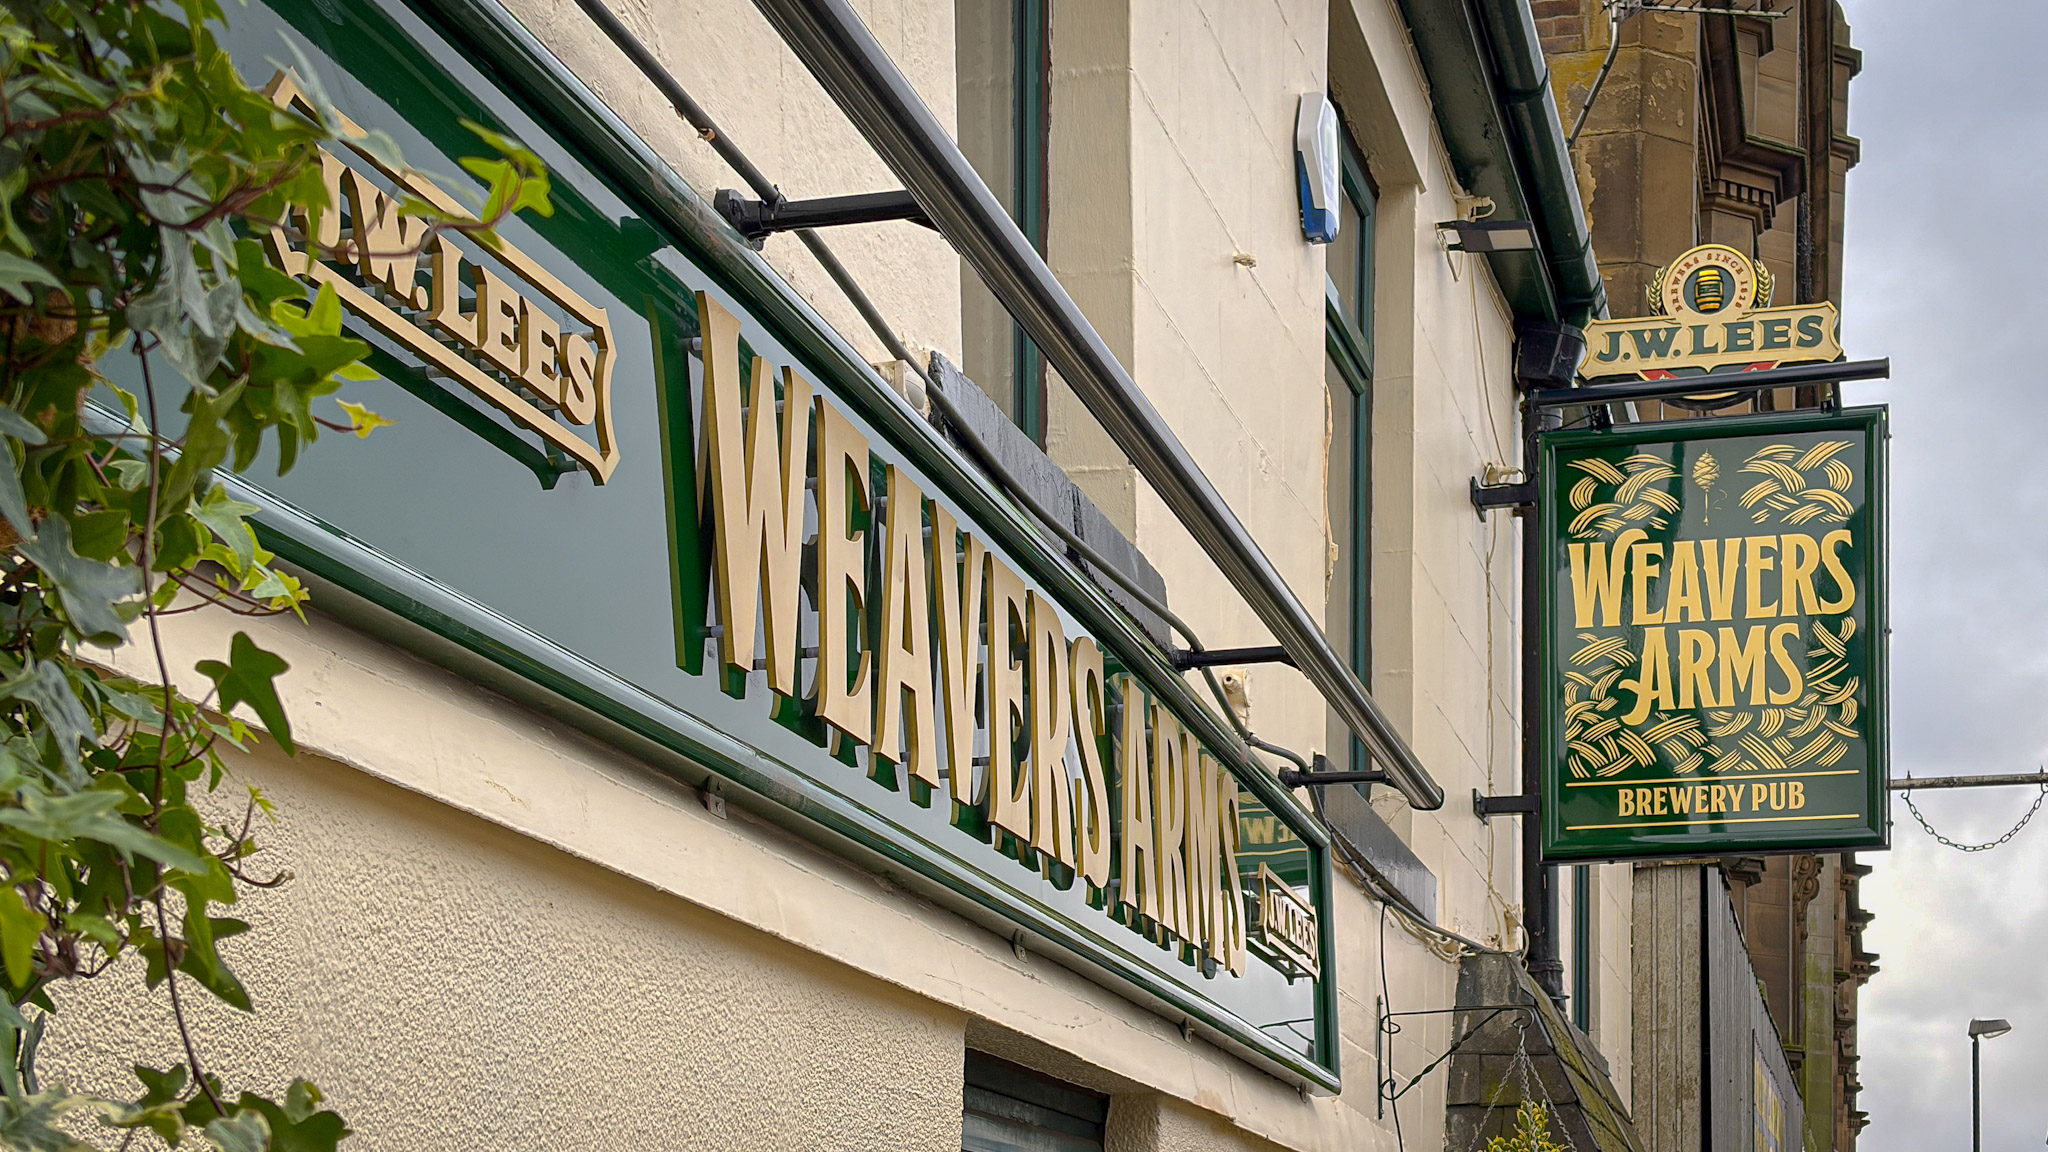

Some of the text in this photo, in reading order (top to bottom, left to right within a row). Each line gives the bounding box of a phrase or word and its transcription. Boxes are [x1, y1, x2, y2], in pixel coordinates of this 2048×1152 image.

[1671, 253, 1748, 312] BREWERS SINCE 1828
[1567, 529, 1856, 628] WEAVERS
[697, 290, 1247, 978] WEAVERS ARMS
[1618, 622, 1804, 726] ARMS
[1618, 781, 1805, 817] BREWERY PUB
